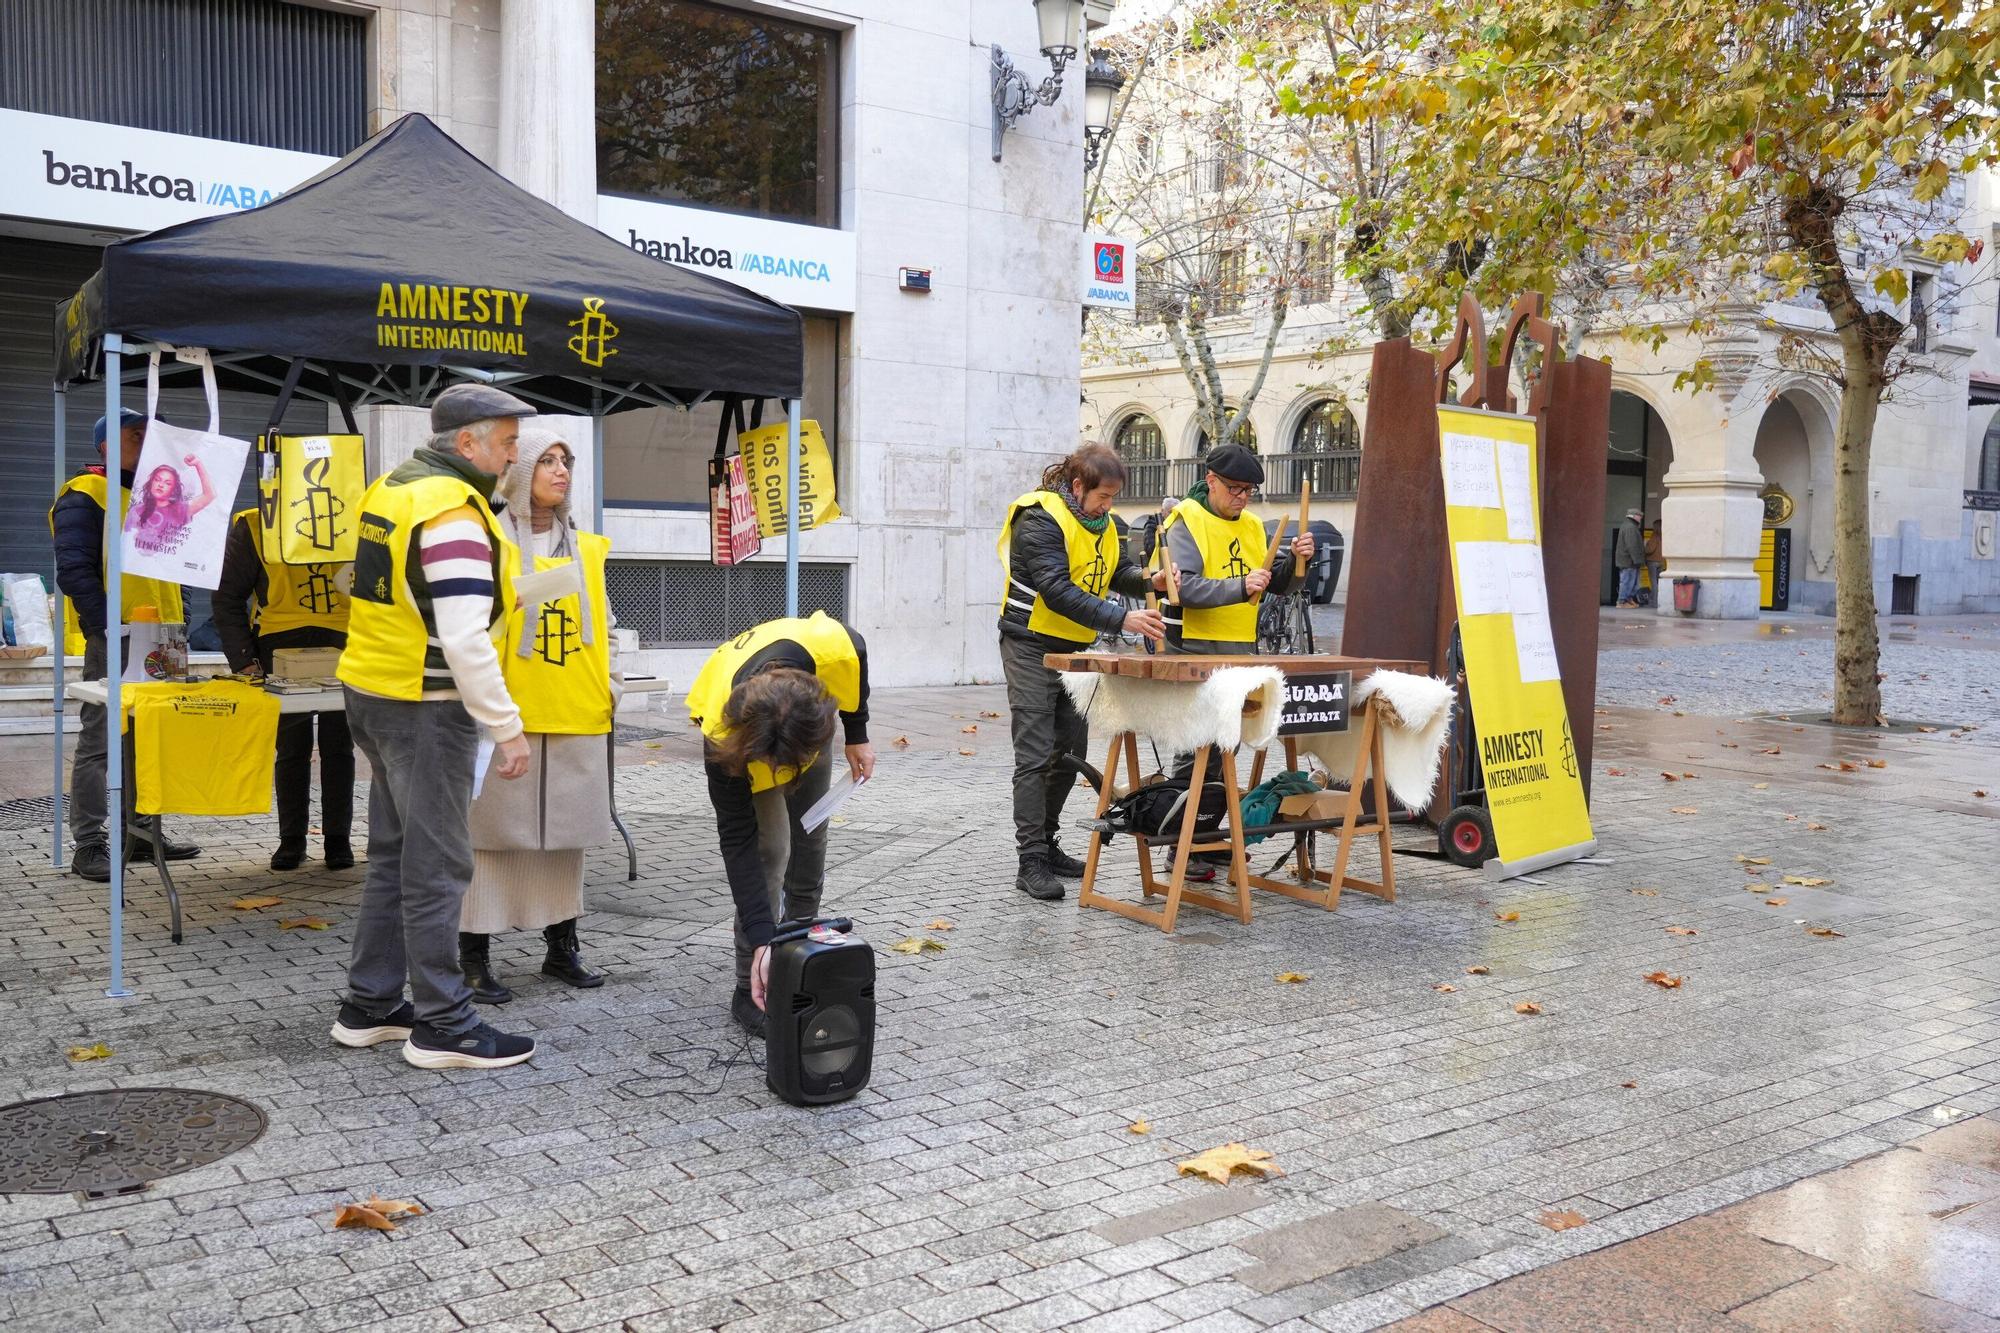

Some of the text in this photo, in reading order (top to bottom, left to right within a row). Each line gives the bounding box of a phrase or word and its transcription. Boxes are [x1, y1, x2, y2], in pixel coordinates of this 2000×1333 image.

[42, 149, 196, 203] bankoa
[628, 229, 733, 270] bankoa
[376, 282, 529, 326] AMNESTY
[377, 324, 528, 356] INTERNATIONAL
[1777, 537, 1788, 601] CORREOS
[1483, 729, 1543, 766] AMNESTY
[1487, 762, 1550, 790] INTERNATIONAL
